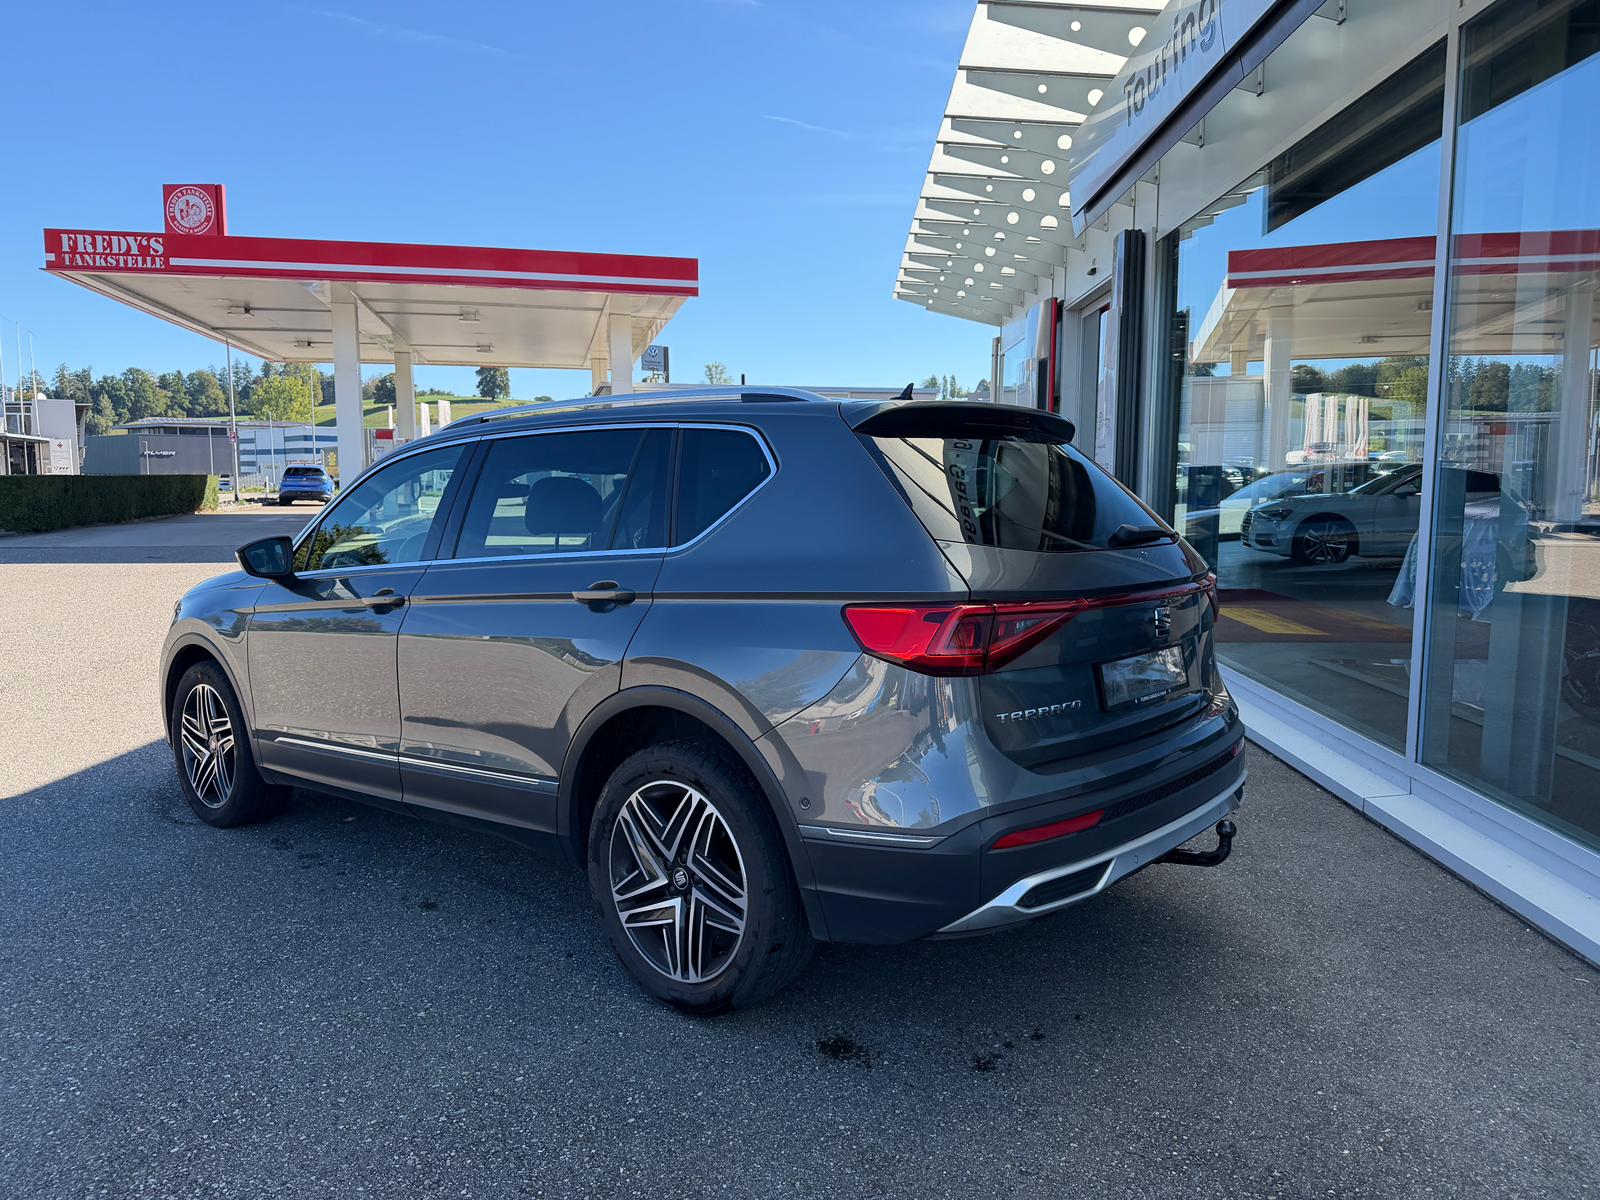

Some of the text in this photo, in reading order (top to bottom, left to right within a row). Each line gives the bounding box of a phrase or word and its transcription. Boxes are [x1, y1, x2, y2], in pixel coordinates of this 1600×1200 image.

[1123, 0, 1216, 127] Touring
[182, 189, 212, 217] TANKSTELLE
[60, 233, 164, 256] FREDY'S
[61, 253, 165, 269] TANKSTELLE
[996, 699, 1082, 724] TARRACO
